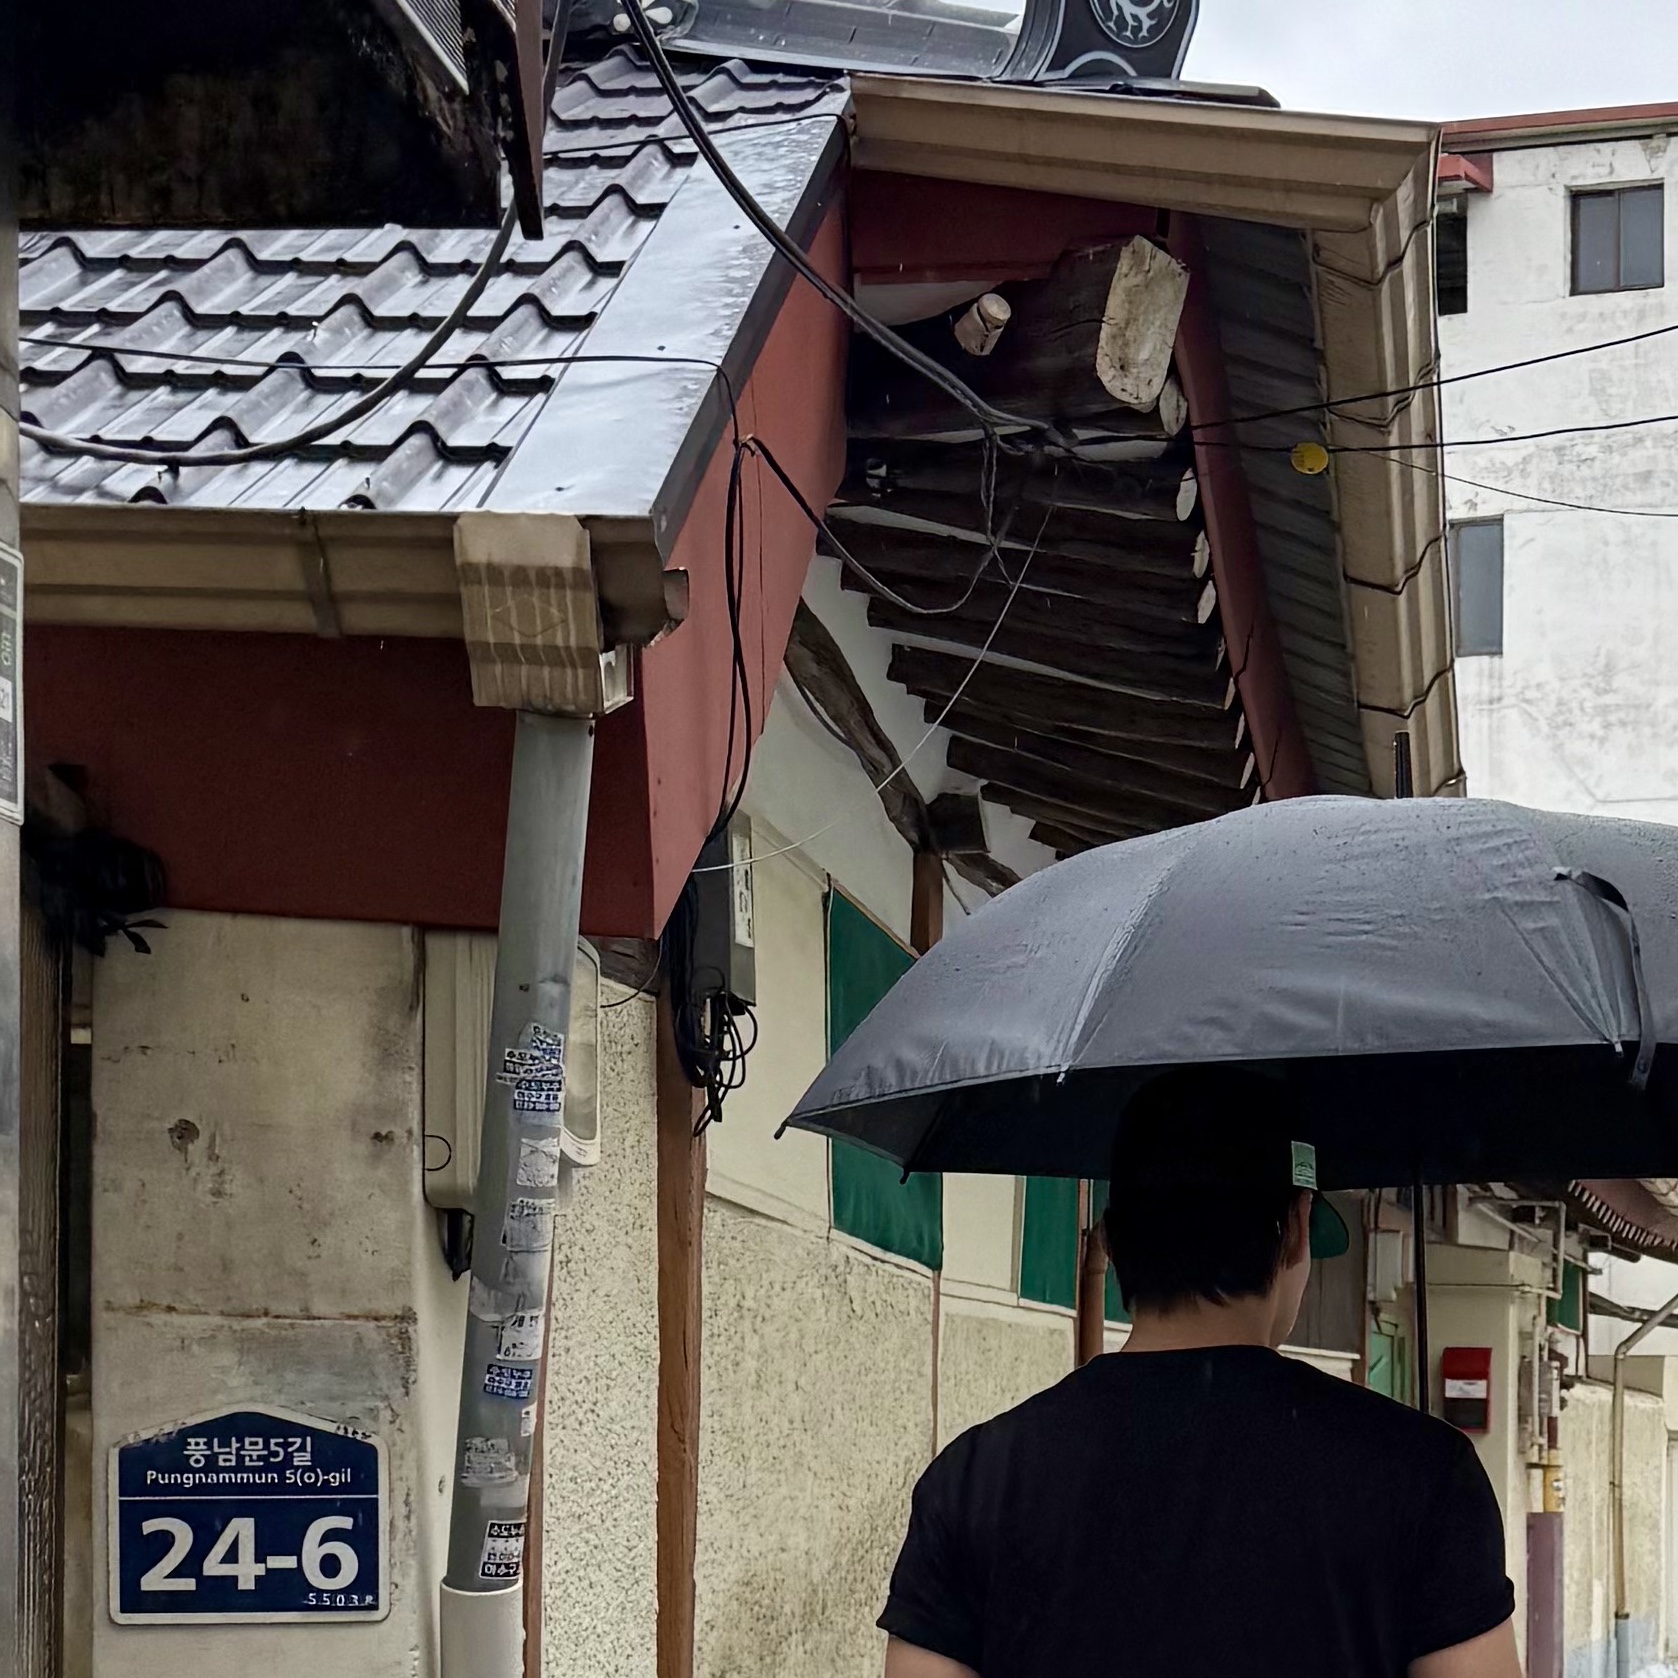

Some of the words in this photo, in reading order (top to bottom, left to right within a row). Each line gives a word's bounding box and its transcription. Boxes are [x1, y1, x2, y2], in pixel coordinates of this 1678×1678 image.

[183, 1435, 312, 1468] 풍남문5길
[146, 1469, 278, 1488] Pungnammun
[285, 1468, 352, 1487] 5(o)-gil
[140, 1515, 360, 1592] 24-6
